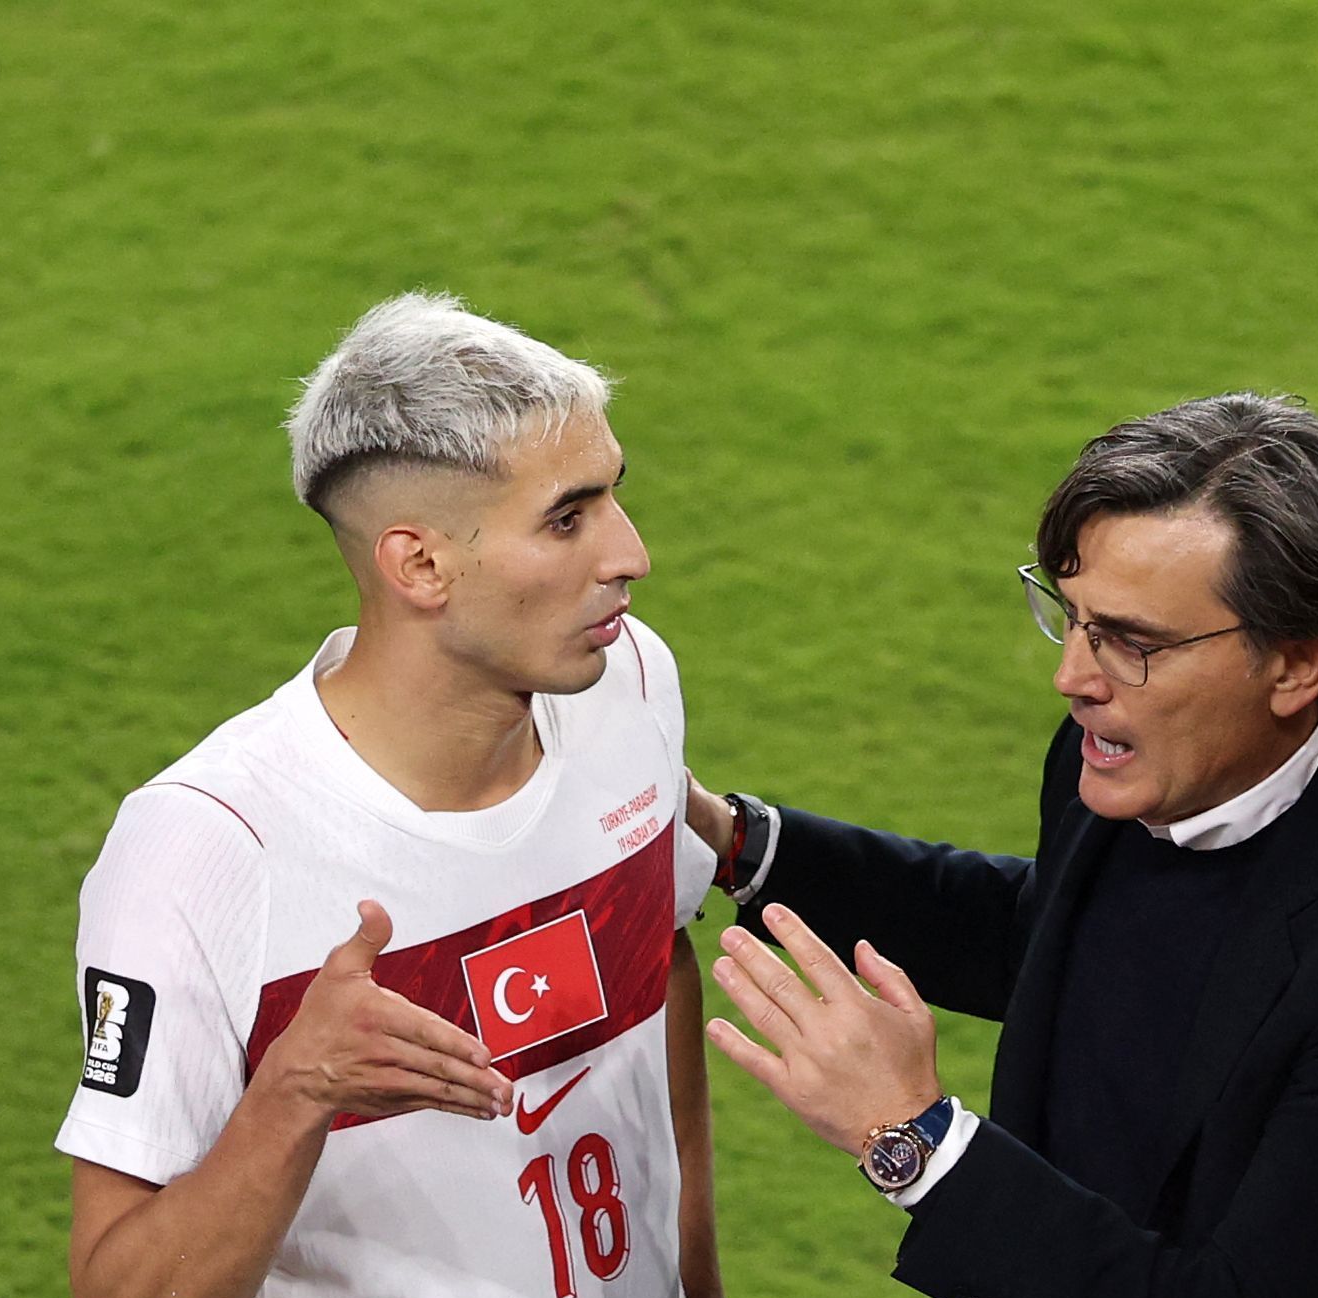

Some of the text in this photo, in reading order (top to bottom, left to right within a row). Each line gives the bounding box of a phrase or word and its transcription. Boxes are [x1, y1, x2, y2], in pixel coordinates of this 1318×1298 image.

[87, 1058, 119, 1073] RLD CUP
[84, 1066, 117, 1085] 026
